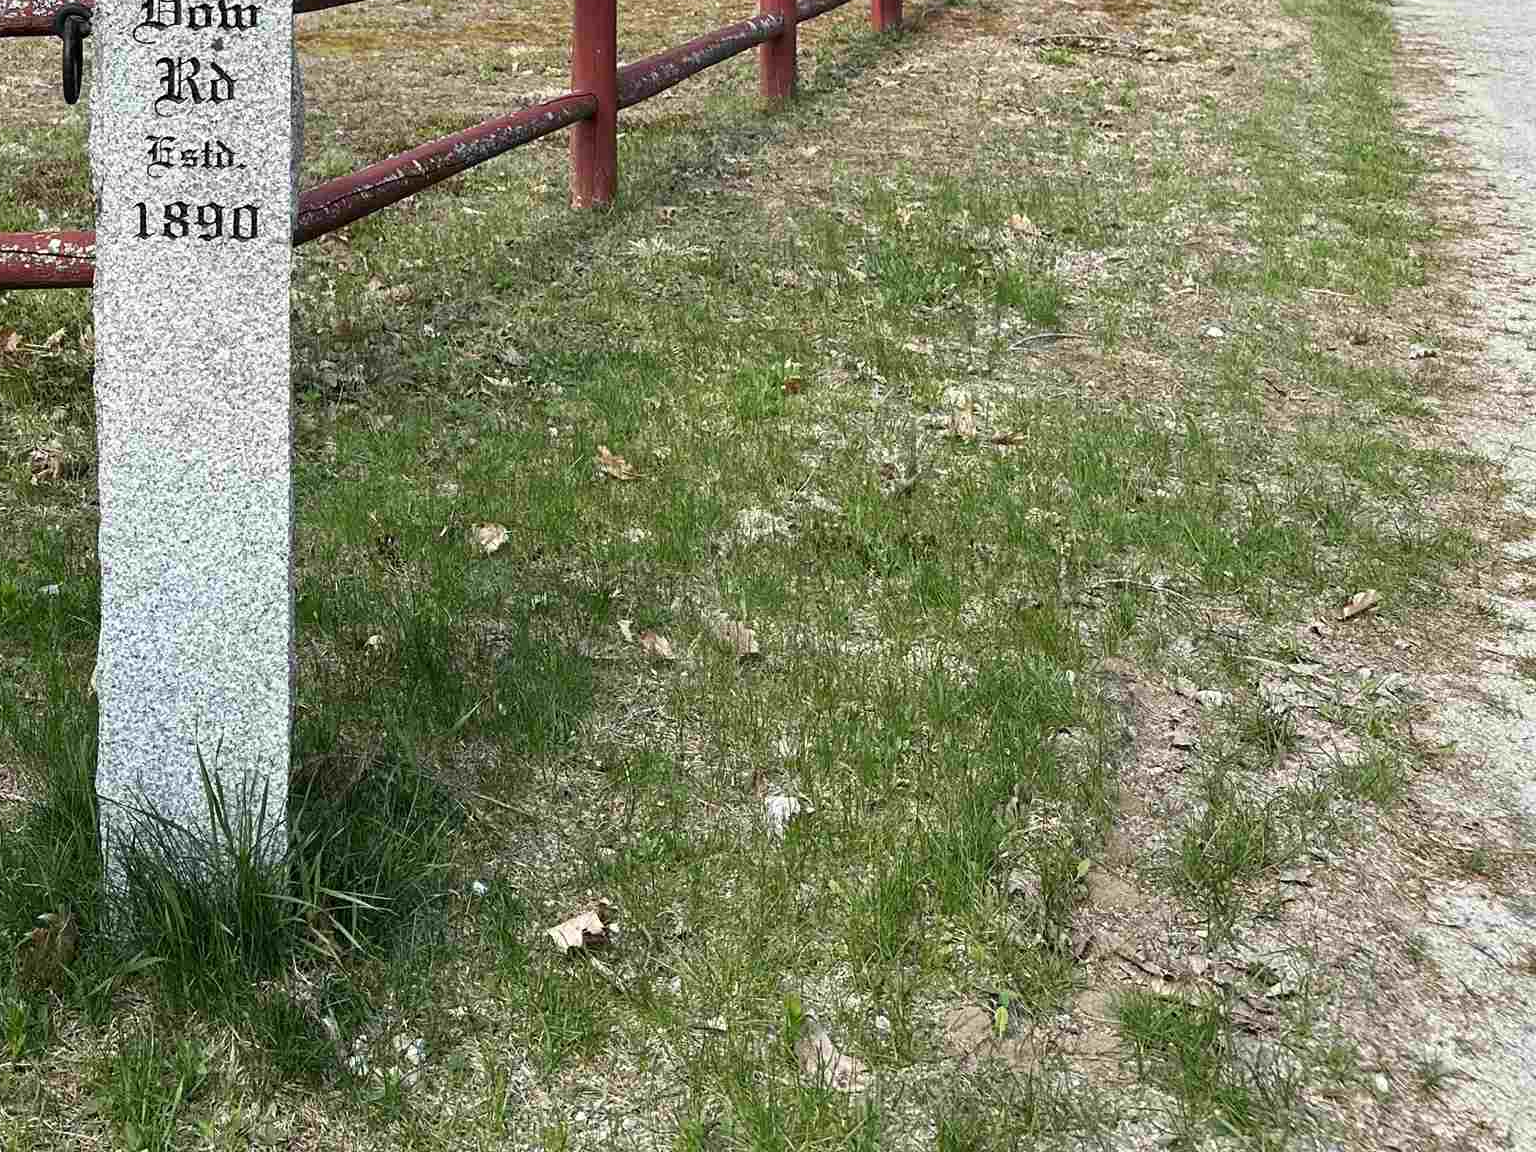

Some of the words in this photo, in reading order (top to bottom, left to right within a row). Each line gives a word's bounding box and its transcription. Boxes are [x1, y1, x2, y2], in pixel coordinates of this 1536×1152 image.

[154, 56, 238, 117] Rd
[145, 135, 247, 178] Estd.
[133, 201, 260, 241] 1890
